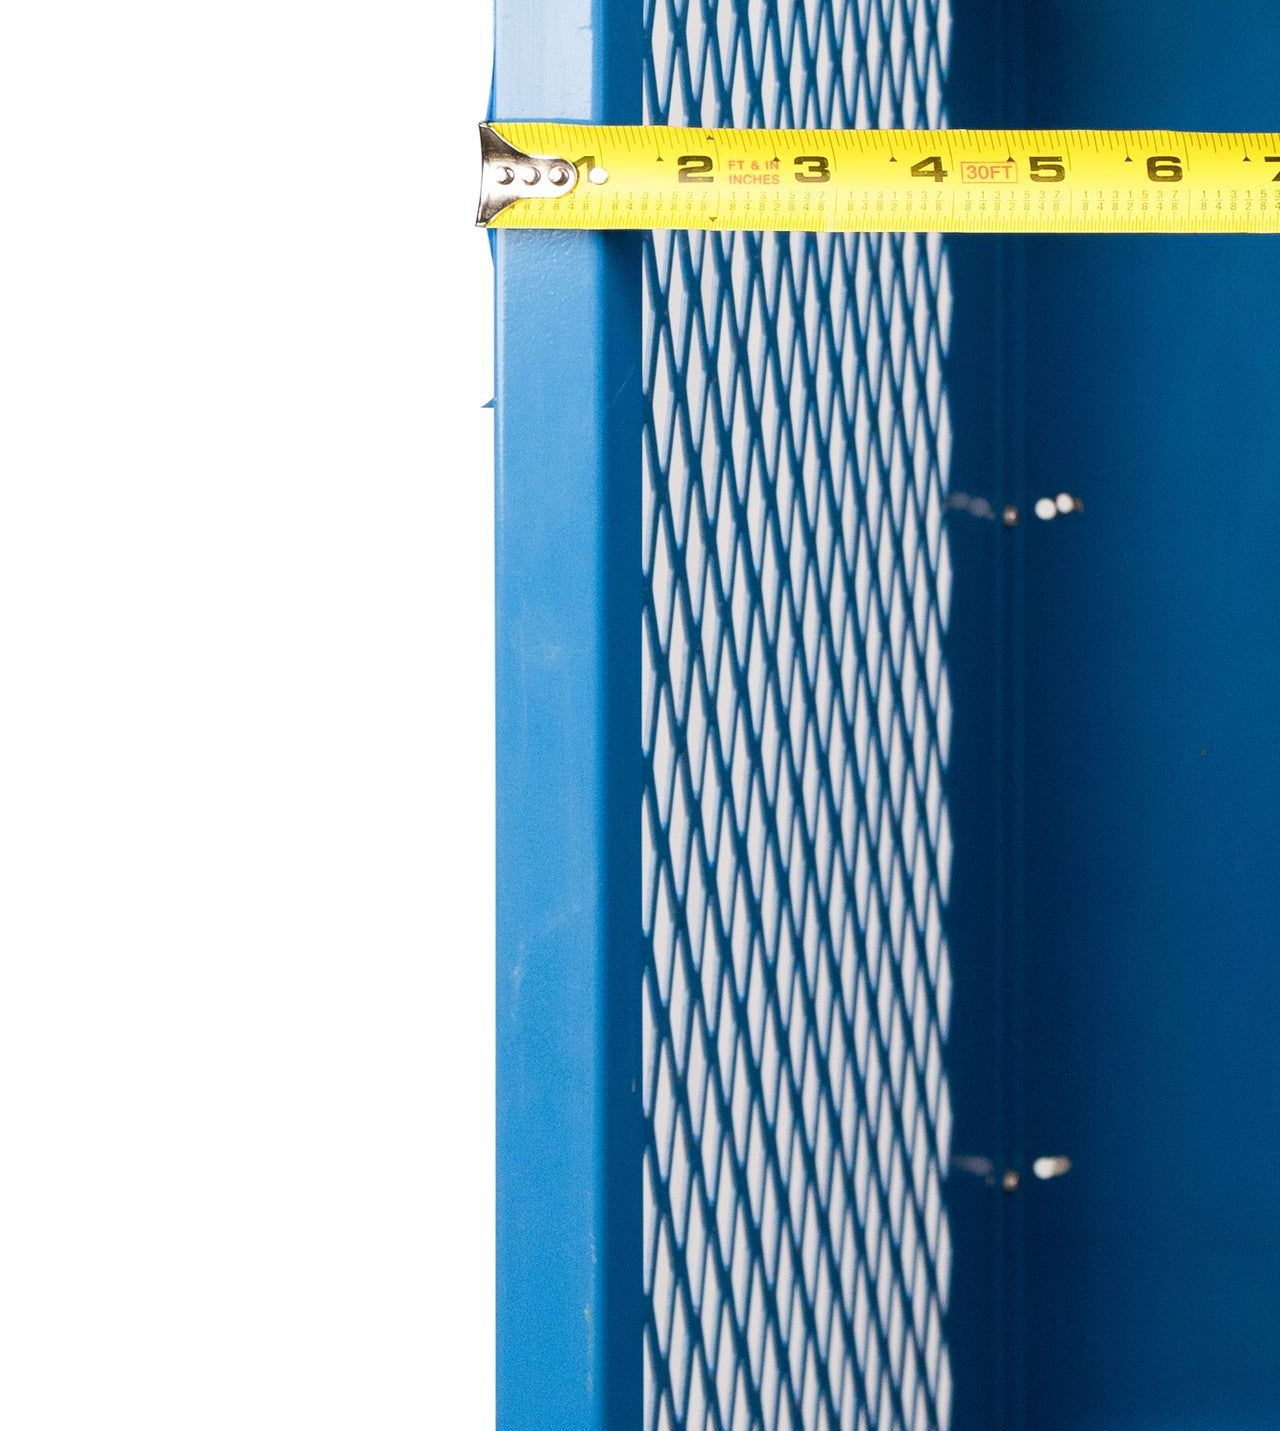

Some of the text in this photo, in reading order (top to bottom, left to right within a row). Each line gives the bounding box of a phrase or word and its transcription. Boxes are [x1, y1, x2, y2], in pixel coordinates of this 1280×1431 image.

[677, 156, 714, 183] 2
[728, 160, 780, 171] FT & IN
[794, 156, 831, 183] 3
[911, 156, 948, 183] 4
[966, 165, 1012, 180] 30FT
[1029, 156, 1066, 183] 5
[1146, 156, 1183, 182] 6
[729, 174, 780, 185] INCHES
